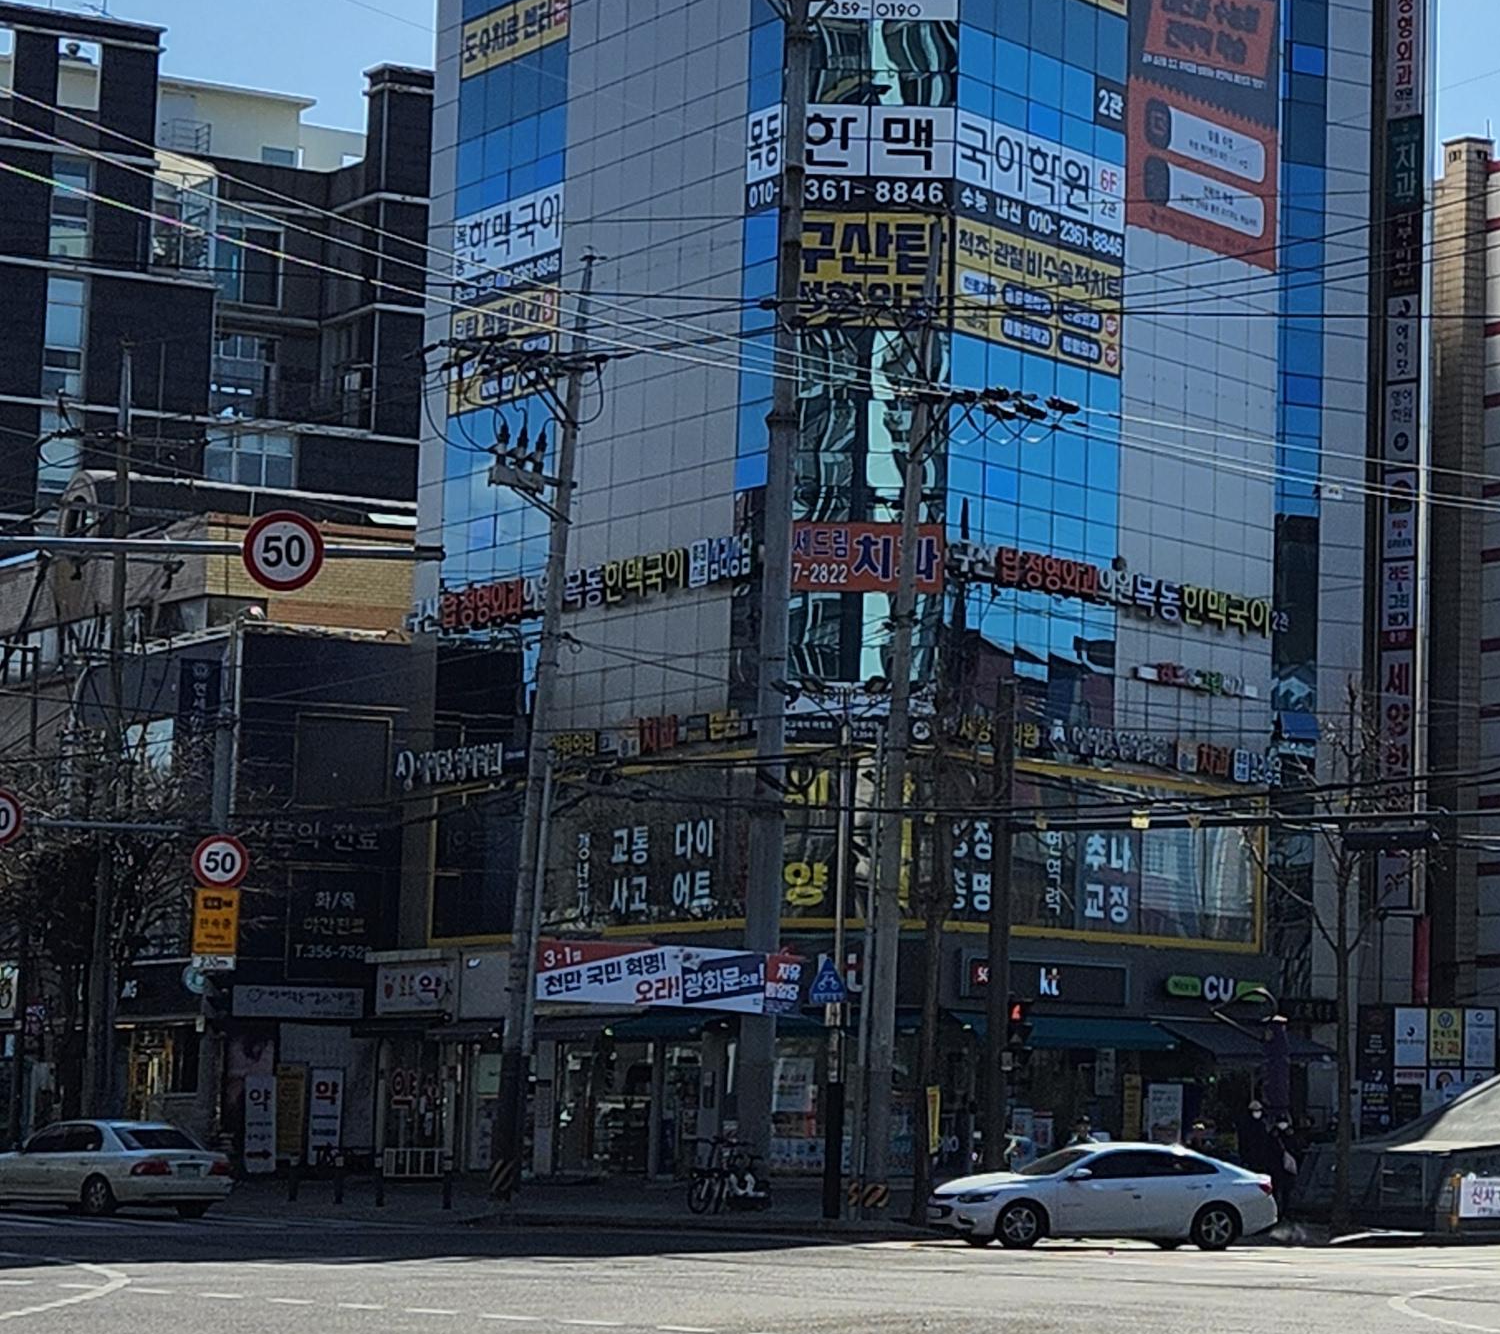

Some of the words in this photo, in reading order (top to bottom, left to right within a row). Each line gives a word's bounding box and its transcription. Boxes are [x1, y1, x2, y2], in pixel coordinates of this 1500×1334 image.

[875, 3, 922, 18] 0190
[1098, 88, 1124, 121] 2관
[806, 112, 934, 171] 한맥
[960, 121, 1091, 216] 국어학원
[1099, 170, 1118, 194] 6F
[748, 180, 781, 208] 010-
[875, 180, 944, 203] 8846
[261, 533, 306, 570] 50
[604, 548, 685, 603] 한맥국어
[1135, 573, 1182, 621] 목동
[1182, 585, 1272, 638] 한맥국어
[611, 825, 650, 865] 교통
[674, 818, 714, 861] 다이
[1084, 833, 1132, 874] 추나
[204, 850, 236, 874] 50
[610, 875, 648, 915] 사고
[672, 869, 713, 917] 어트
[1083, 883, 1130, 925] 교정
[544, 970, 582, 997] 천만
[586, 961, 622, 986] 국민
[626, 952, 665, 976] 혁명!
[634, 975, 680, 1004] 오라!
[1038, 966, 1061, 997] kt
[1203, 974, 1234, 1002] CU
[249, 1088, 272, 1113] 약
[315, 1080, 339, 1106] 약
